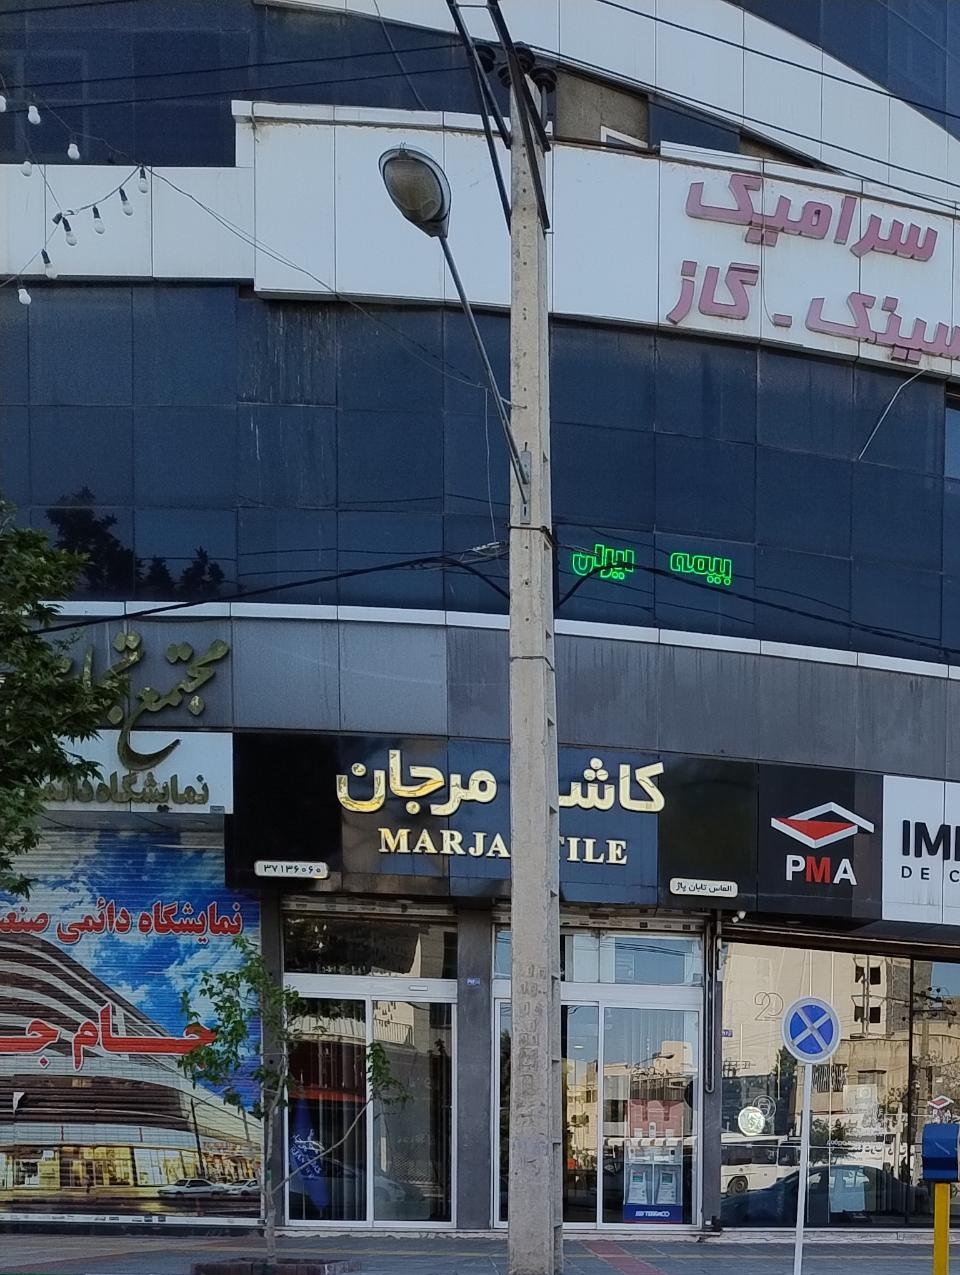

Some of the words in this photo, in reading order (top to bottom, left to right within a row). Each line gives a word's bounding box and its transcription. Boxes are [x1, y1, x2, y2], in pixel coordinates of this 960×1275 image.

[684, 173, 939, 262] سرامیک
[666, 260, 760, 325] گاز
[669, 552, 733, 586] بیمه
[96, 771, 210, 813] نمایشگاه
[336, 749, 498, 816] مرجان
[559, 757, 665, 813] کاش
[378, 828, 511, 858] MARJA
[559, 837, 628, 866] ILE
[785, 854, 858, 886] PMA
[901, 865, 931, 881] DE
[56, 896, 132, 944] دائمی
[138, 900, 244, 943] نمایشگاه
